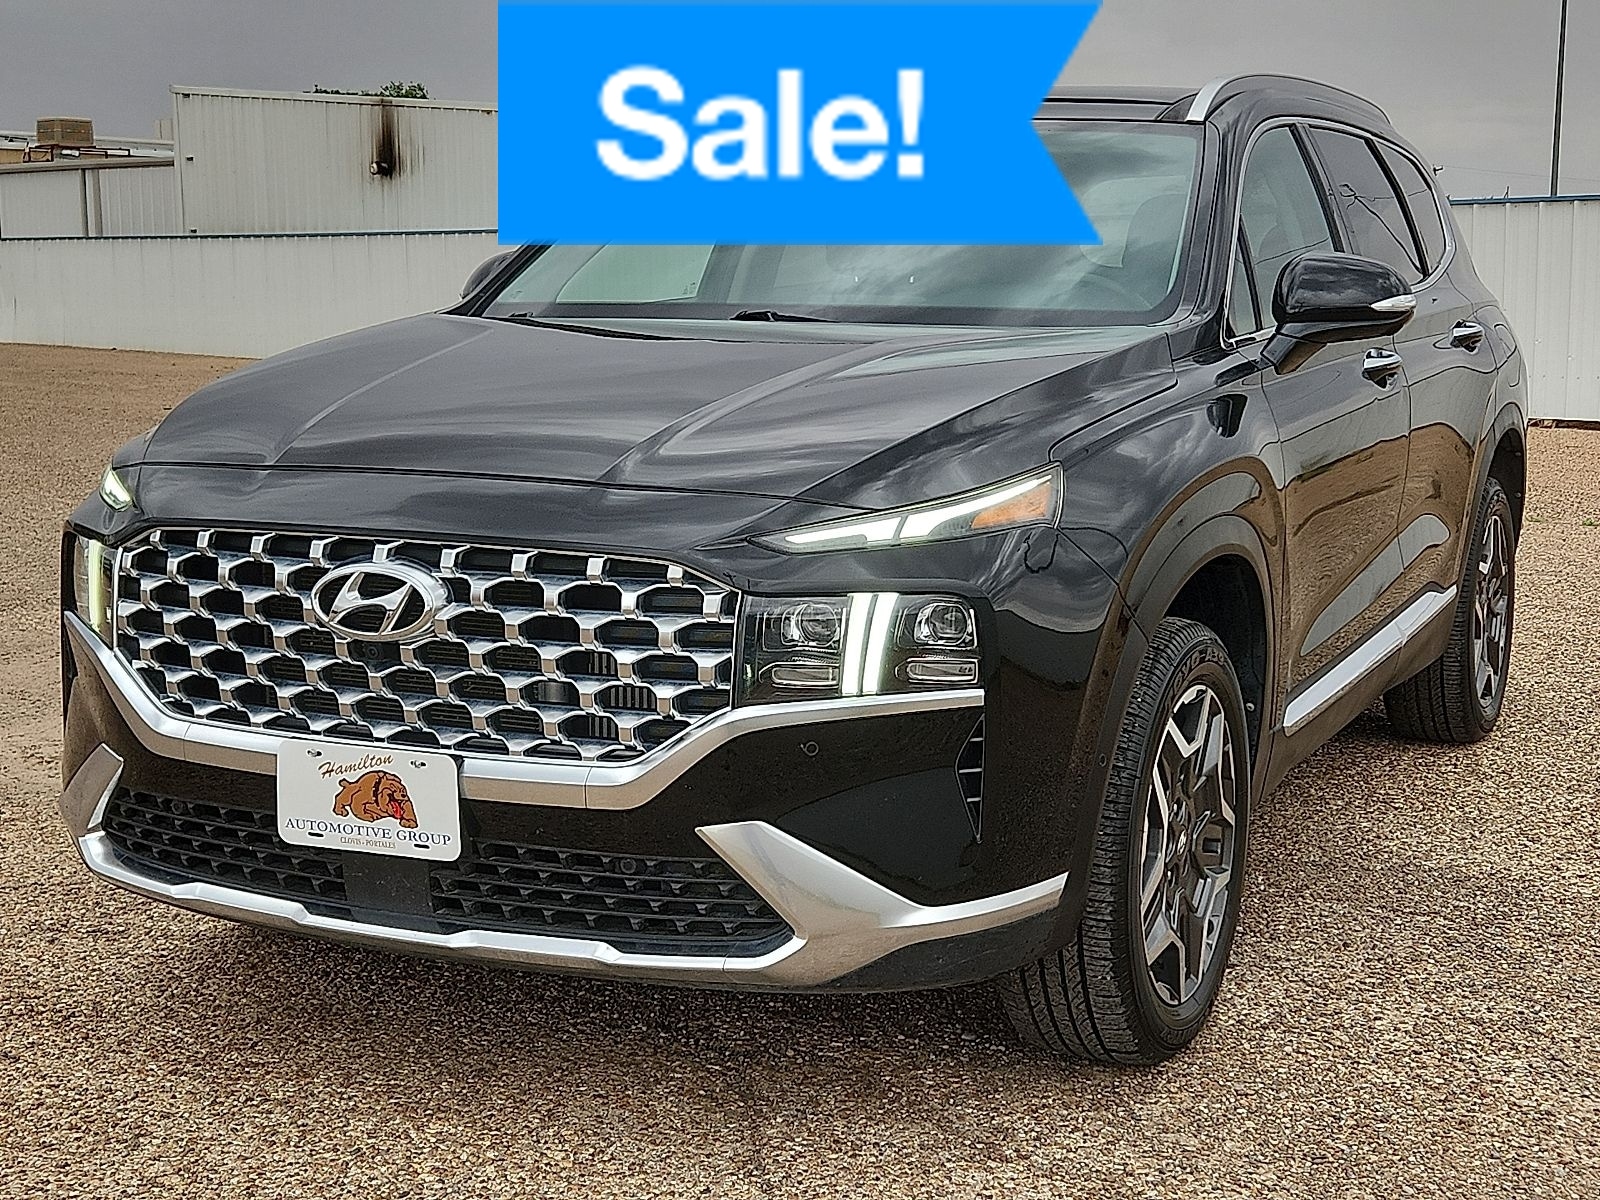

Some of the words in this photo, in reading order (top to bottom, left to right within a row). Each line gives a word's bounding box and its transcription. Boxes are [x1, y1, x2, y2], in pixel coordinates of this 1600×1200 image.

[318, 753, 394, 779] Hamilton
[285, 818, 392, 840] AUTOMOTIVE
[396, 829, 451, 846] GROUP
[340, 836, 361, 845] CLOVIS
[366, 839, 396, 849] PORTALES
